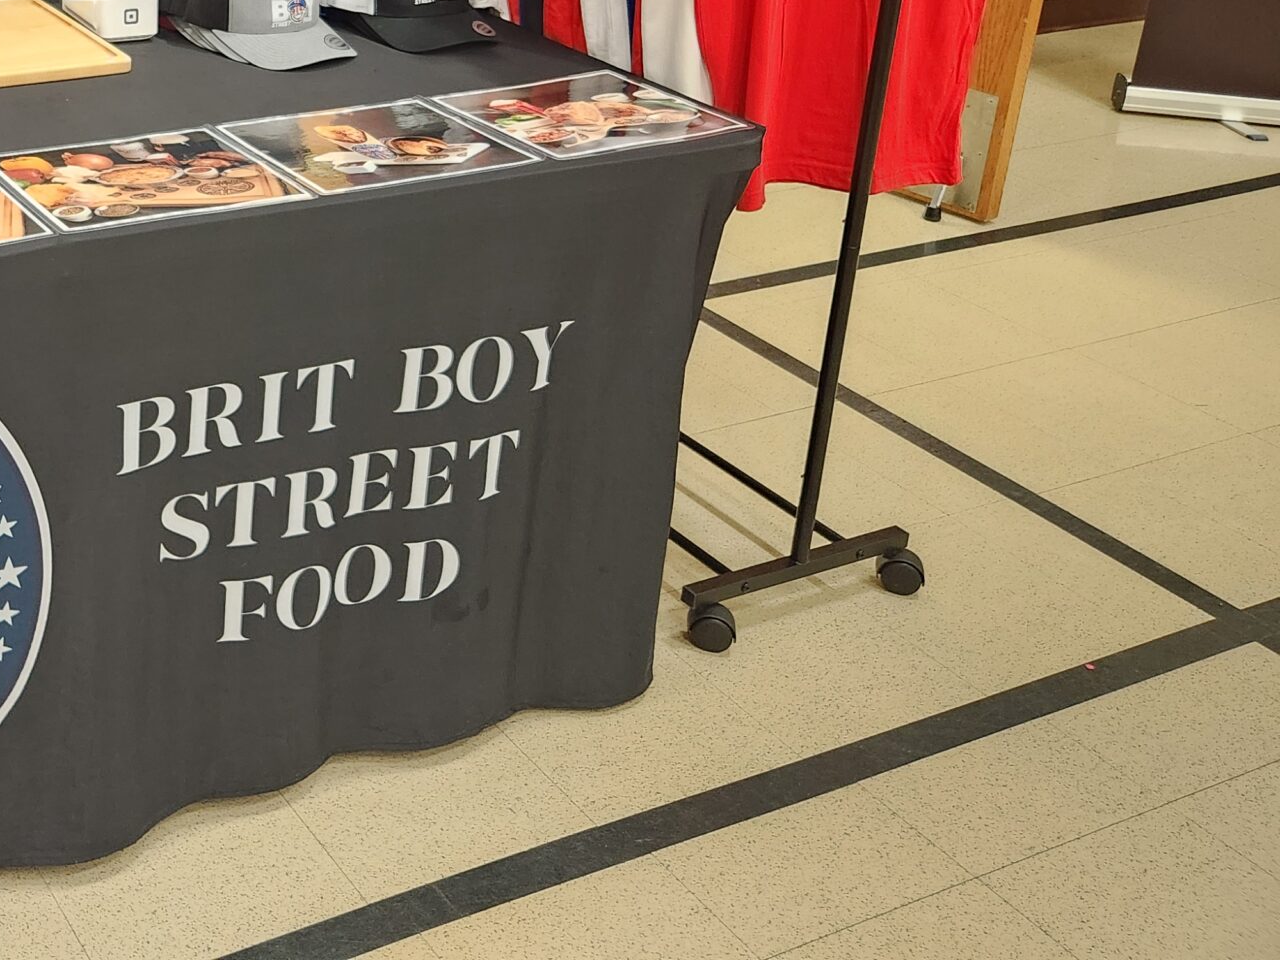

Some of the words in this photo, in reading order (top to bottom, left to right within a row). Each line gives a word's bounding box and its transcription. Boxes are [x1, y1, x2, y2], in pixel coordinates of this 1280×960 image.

[116, 358, 355, 476] BRIT
[393, 320, 575, 414] BOY
[159, 429, 520, 563] STREET
[216, 538, 461, 643] FOOD
